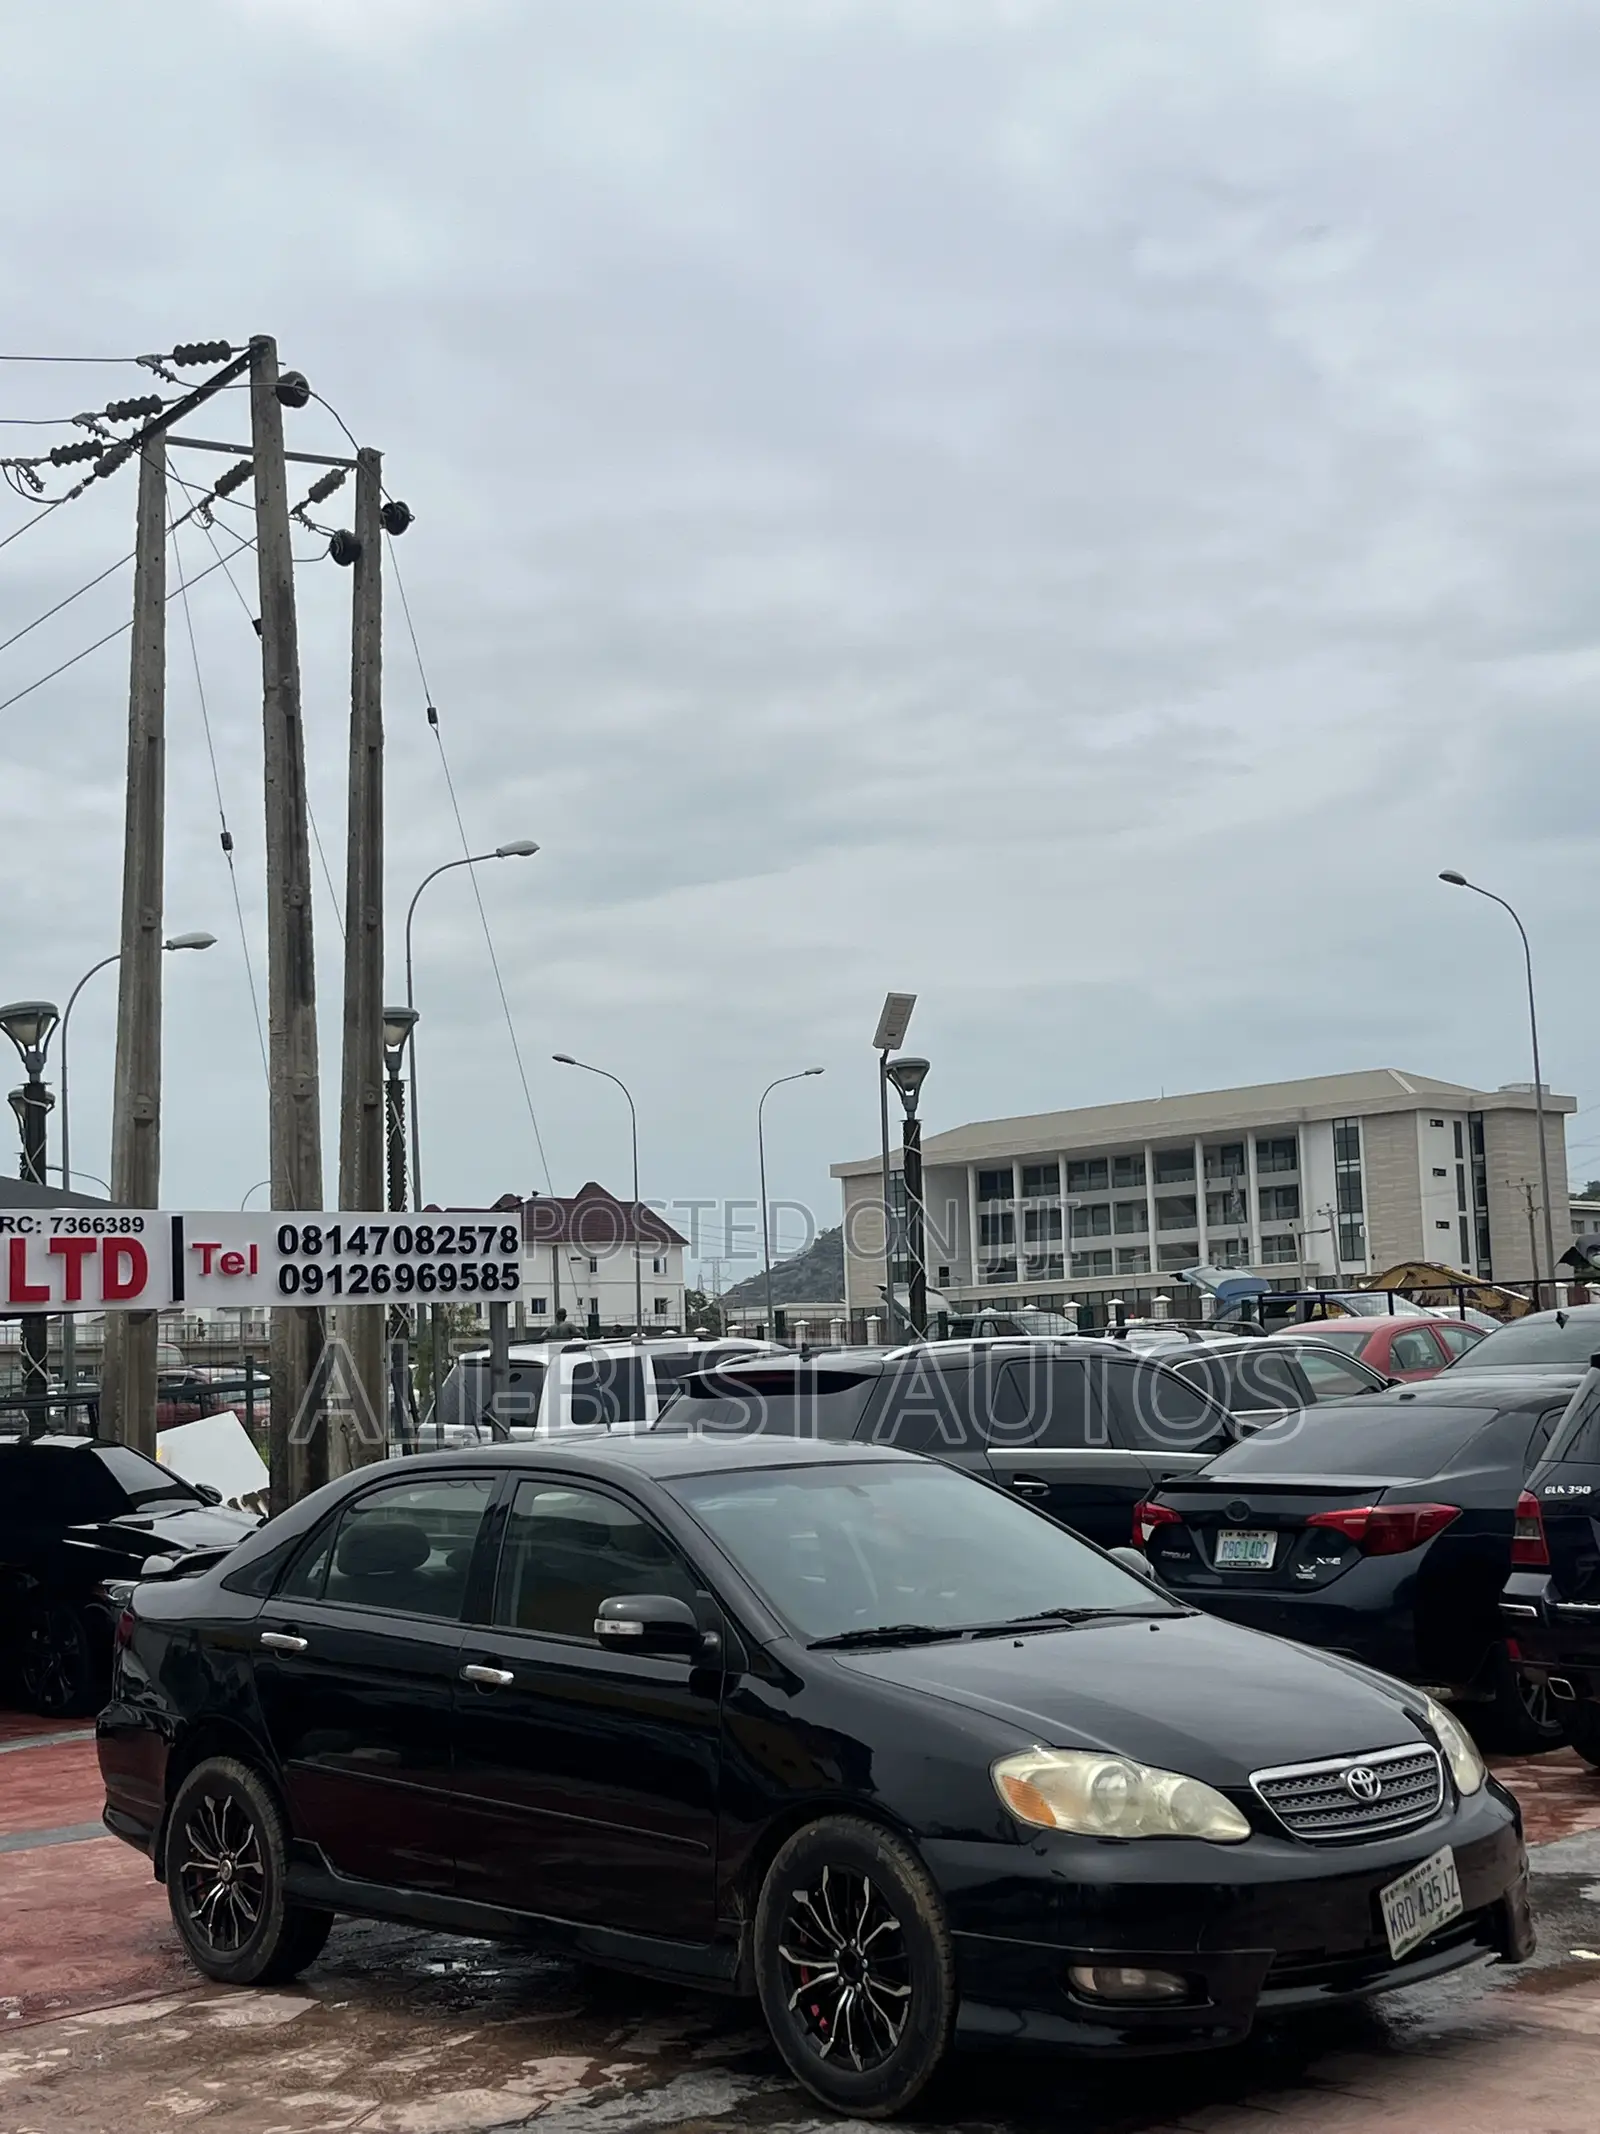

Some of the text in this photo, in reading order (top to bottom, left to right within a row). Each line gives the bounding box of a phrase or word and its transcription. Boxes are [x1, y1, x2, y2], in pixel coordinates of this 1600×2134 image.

[0, 1216, 145, 1234] RC: 7366389
[277, 1224, 519, 1256] 08147082578
[9, 1237, 149, 1302] LTD
[192, 1242, 258, 1276] Tel
[278, 1262, 520, 1294] 09126969585
[1388, 1865, 1459, 1942] KRD-435JZ
